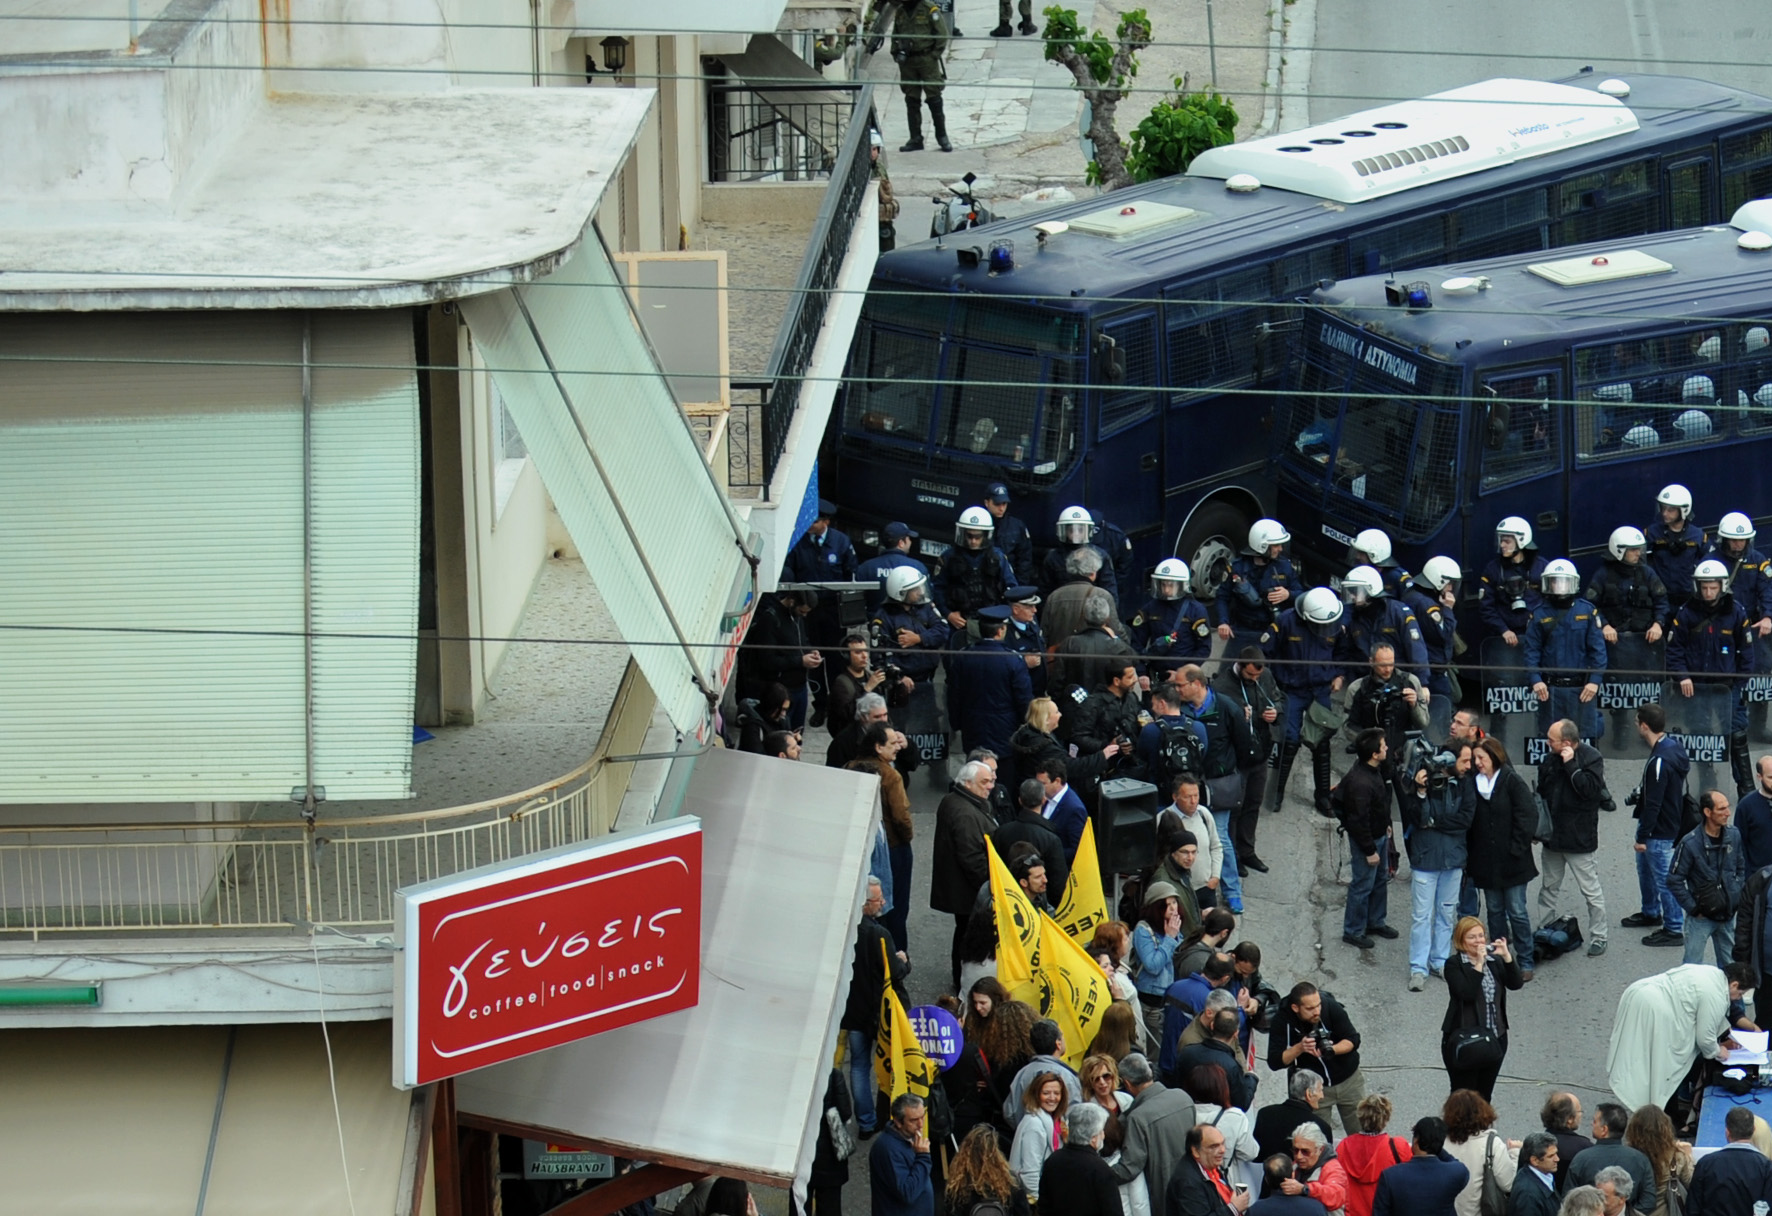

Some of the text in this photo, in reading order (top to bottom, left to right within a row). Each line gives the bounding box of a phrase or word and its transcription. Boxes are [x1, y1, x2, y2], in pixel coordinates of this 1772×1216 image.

[1364, 345, 1417, 385] ΑΣΤΥΝΟΜΙΑ
[1324, 527, 1352, 545] POLICE
[1486, 686, 1541, 702] ΑΣΤΥΝΟ
[1598, 682, 1662, 698] ΑΣΤΥΝΟΜΙΑ
[1489, 701, 1540, 714] POLIC
[1687, 750, 1723, 762] LICE
[443, 908, 682, 1018] γεύσεις
[469, 954, 665, 1020] coffee food snack
[941, 1025, 951, 1037] ΟΙ
[920, 1039, 956, 1054] ΟΝΑΖΙ
[531, 1162, 606, 1174] HAUSBRANDT
